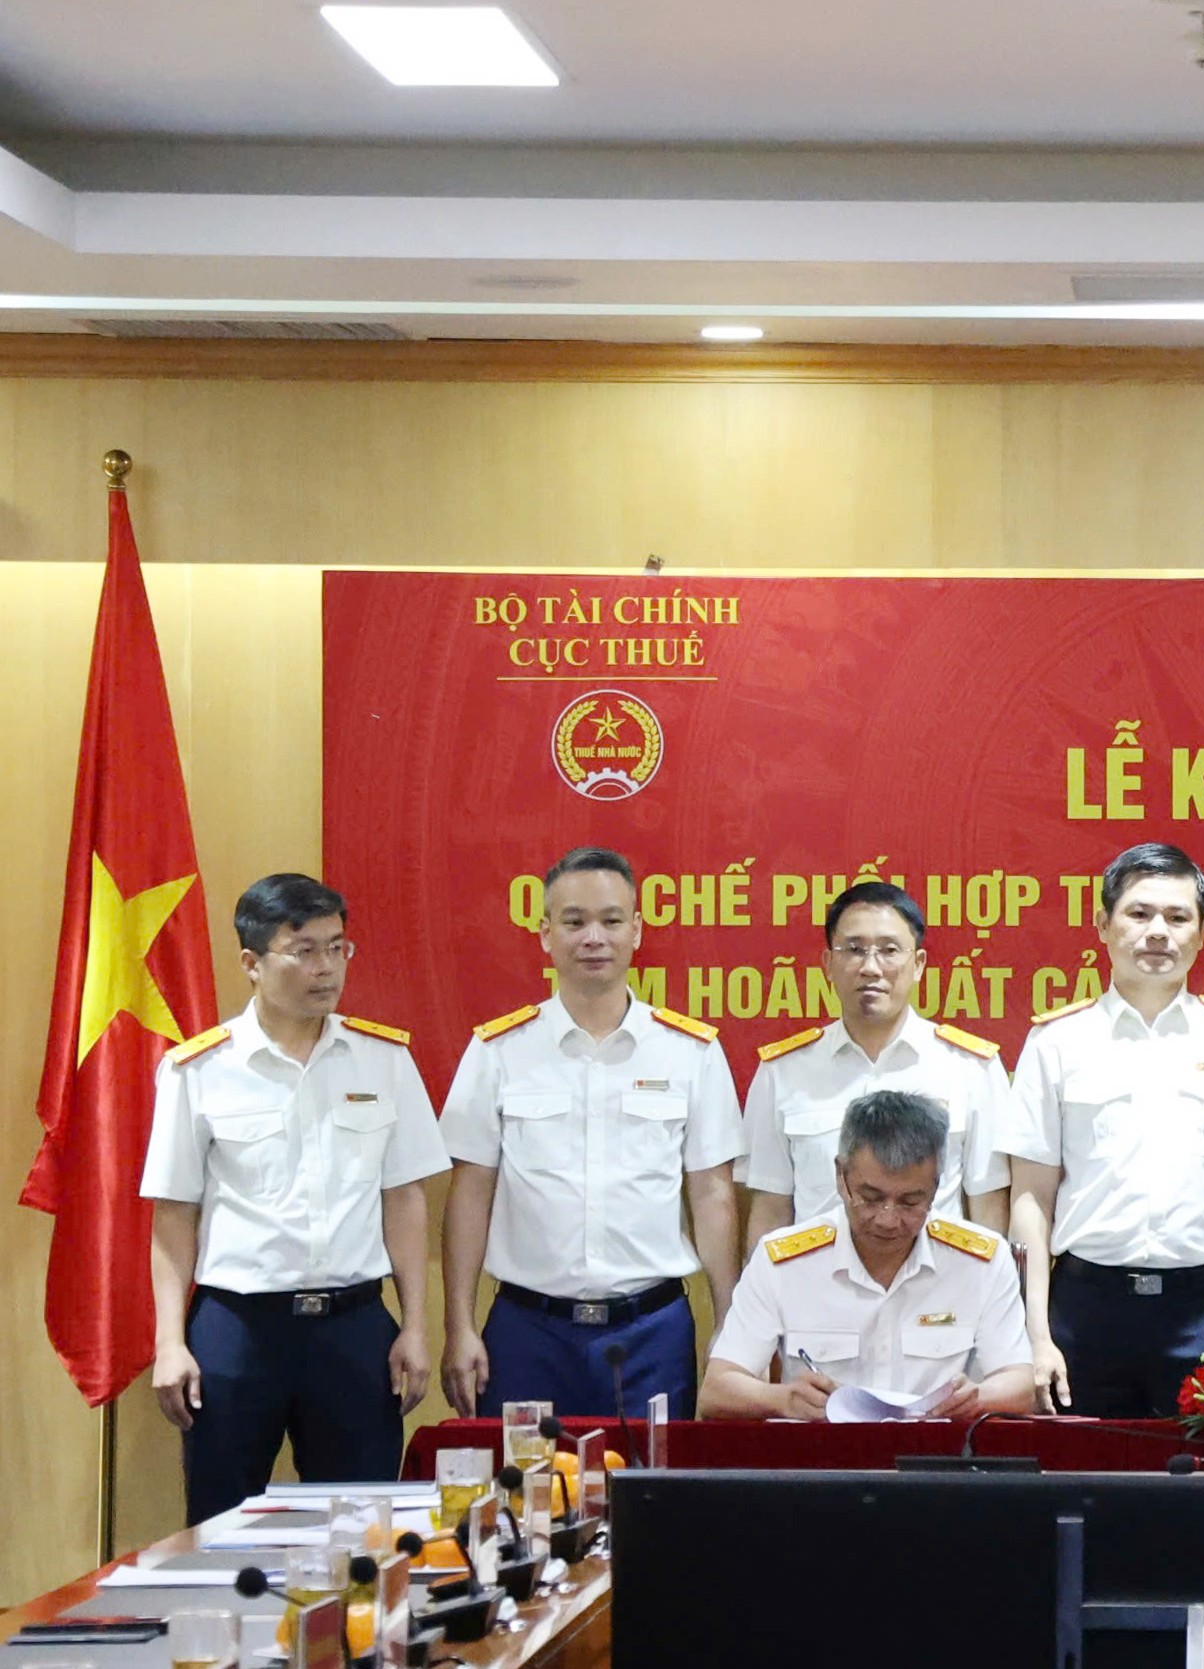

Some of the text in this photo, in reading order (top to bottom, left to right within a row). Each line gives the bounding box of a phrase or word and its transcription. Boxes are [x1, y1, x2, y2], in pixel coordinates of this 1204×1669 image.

[475, 588, 740, 632] BỘ TÀI CHÍNH
[509, 630, 705, 673] CỤC THUẾ
[1066, 719, 1145, 820] LỄ
[641, 857, 756, 927] CHẾ
[926, 869, 1041, 939] HỢP
[908, 948, 1013, 1020] UẤT
